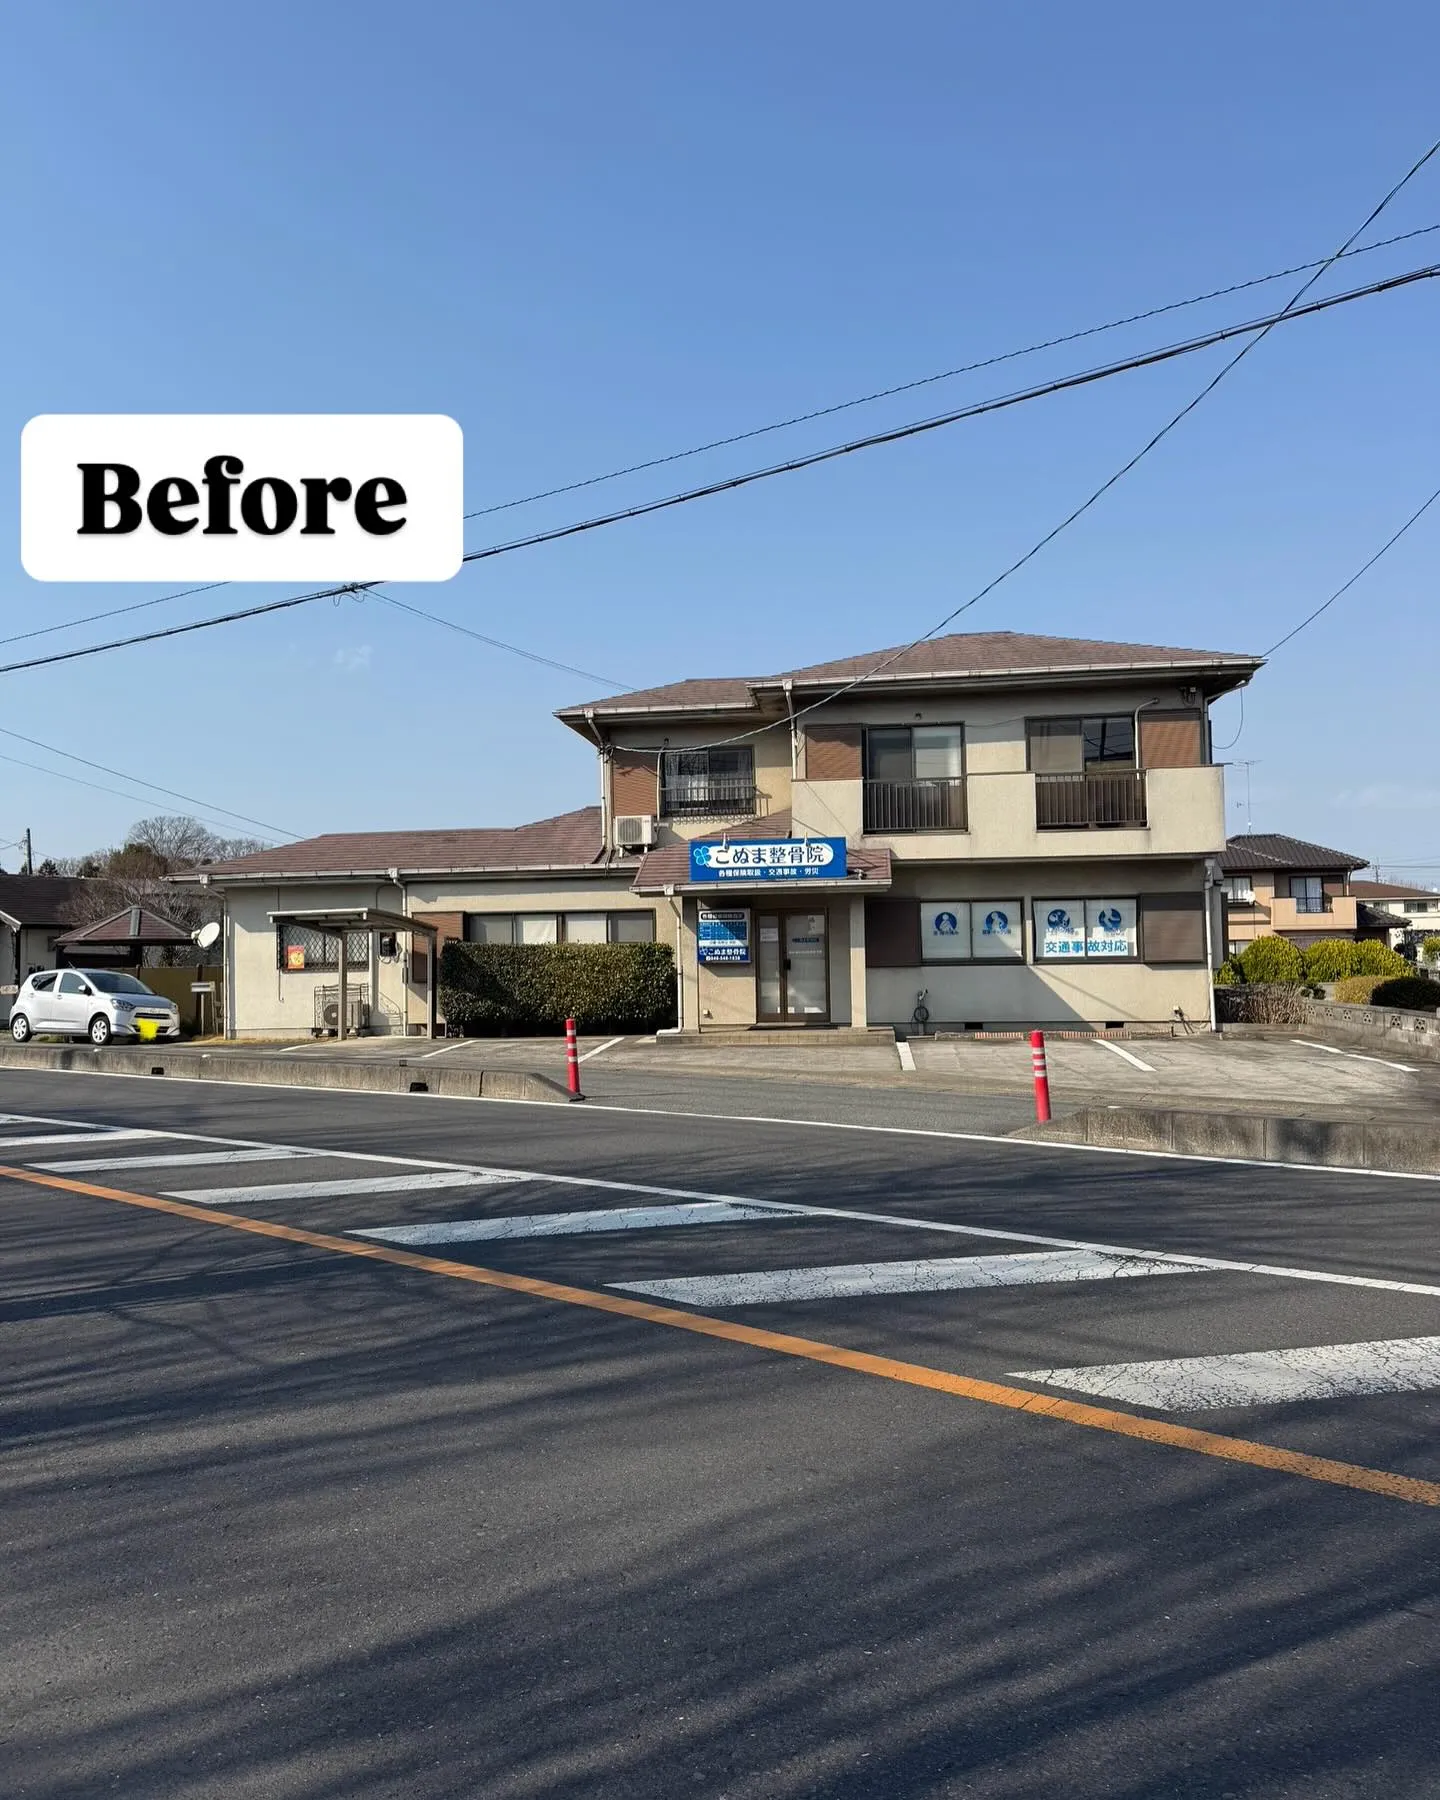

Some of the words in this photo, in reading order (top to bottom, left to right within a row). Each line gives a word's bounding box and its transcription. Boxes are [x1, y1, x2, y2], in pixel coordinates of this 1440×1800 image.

[715, 846, 825, 864] こぬま整骨院
[1045, 939, 1128, 953] 交通事故対応
